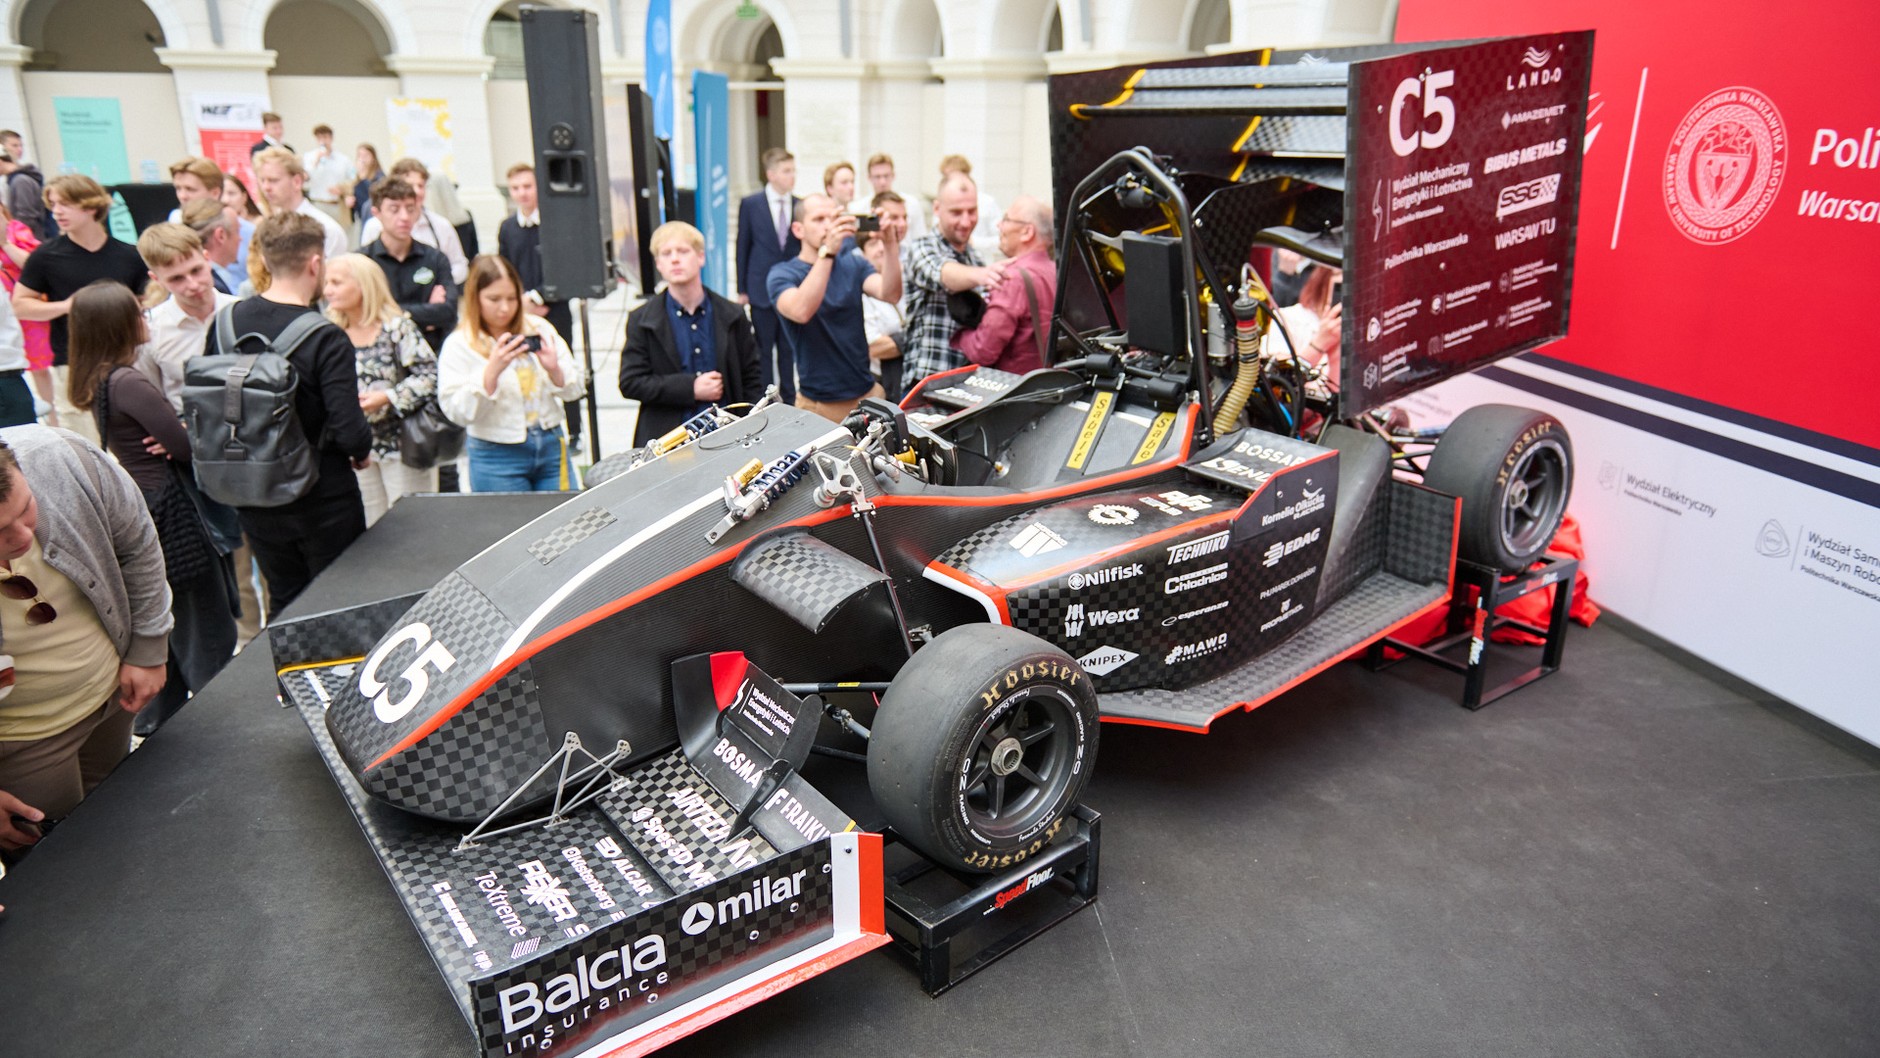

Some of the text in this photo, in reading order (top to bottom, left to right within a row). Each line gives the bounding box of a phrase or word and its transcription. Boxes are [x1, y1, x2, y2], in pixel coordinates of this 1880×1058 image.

[1389, 70, 1455, 156] C5
[1675, 91, 1783, 153] POLITECHNIKA WARSZAWSKA
[1484, 138, 1567, 175] BIBUS METALS
[1666, 153, 1783, 240] WARSAW UNIVERSITY OF TECHNOLOGY
[1797, 189, 1880, 224] Warsa
[1384, 232, 1468, 270] Politechnika Warszawska
[1495, 217, 1556, 251] WARSAW TU
[1074, 399, 1108, 462] Sabelt
[1627, 472, 1717, 518] Wydział Elektryczny
[1262, 506, 1295, 526] Kornelia
[1167, 530, 1230, 565] TECHNIKO
[1284, 528, 1321, 556] EDAG
[1804, 546, 1809, 557] i
[1810, 549, 1851, 573] Maszyn
[1808, 531, 1852, 556] Wydział
[1853, 548, 1880, 568] Sam
[1085, 562, 1144, 587] Nilfisk
[1087, 607, 1140, 627] Wera
[1178, 601, 1229, 620] esperanza
[1079, 654, 1126, 668] KNIPEX
[1183, 632, 1228, 656] MAWO
[359, 622, 457, 723] C5
[980, 660, 1083, 711] Hoosier
[959, 757, 971, 825] OZ RACING
[666, 787, 732, 842] AIRTECH
[643, 817, 677, 849] Spes
[668, 843, 693, 865] 3D
[611, 858, 653, 897] ALCAR
[718, 868, 806, 925] milar
[474, 870, 527, 937] TeXtreme
[499, 933, 667, 1035] Balcia
